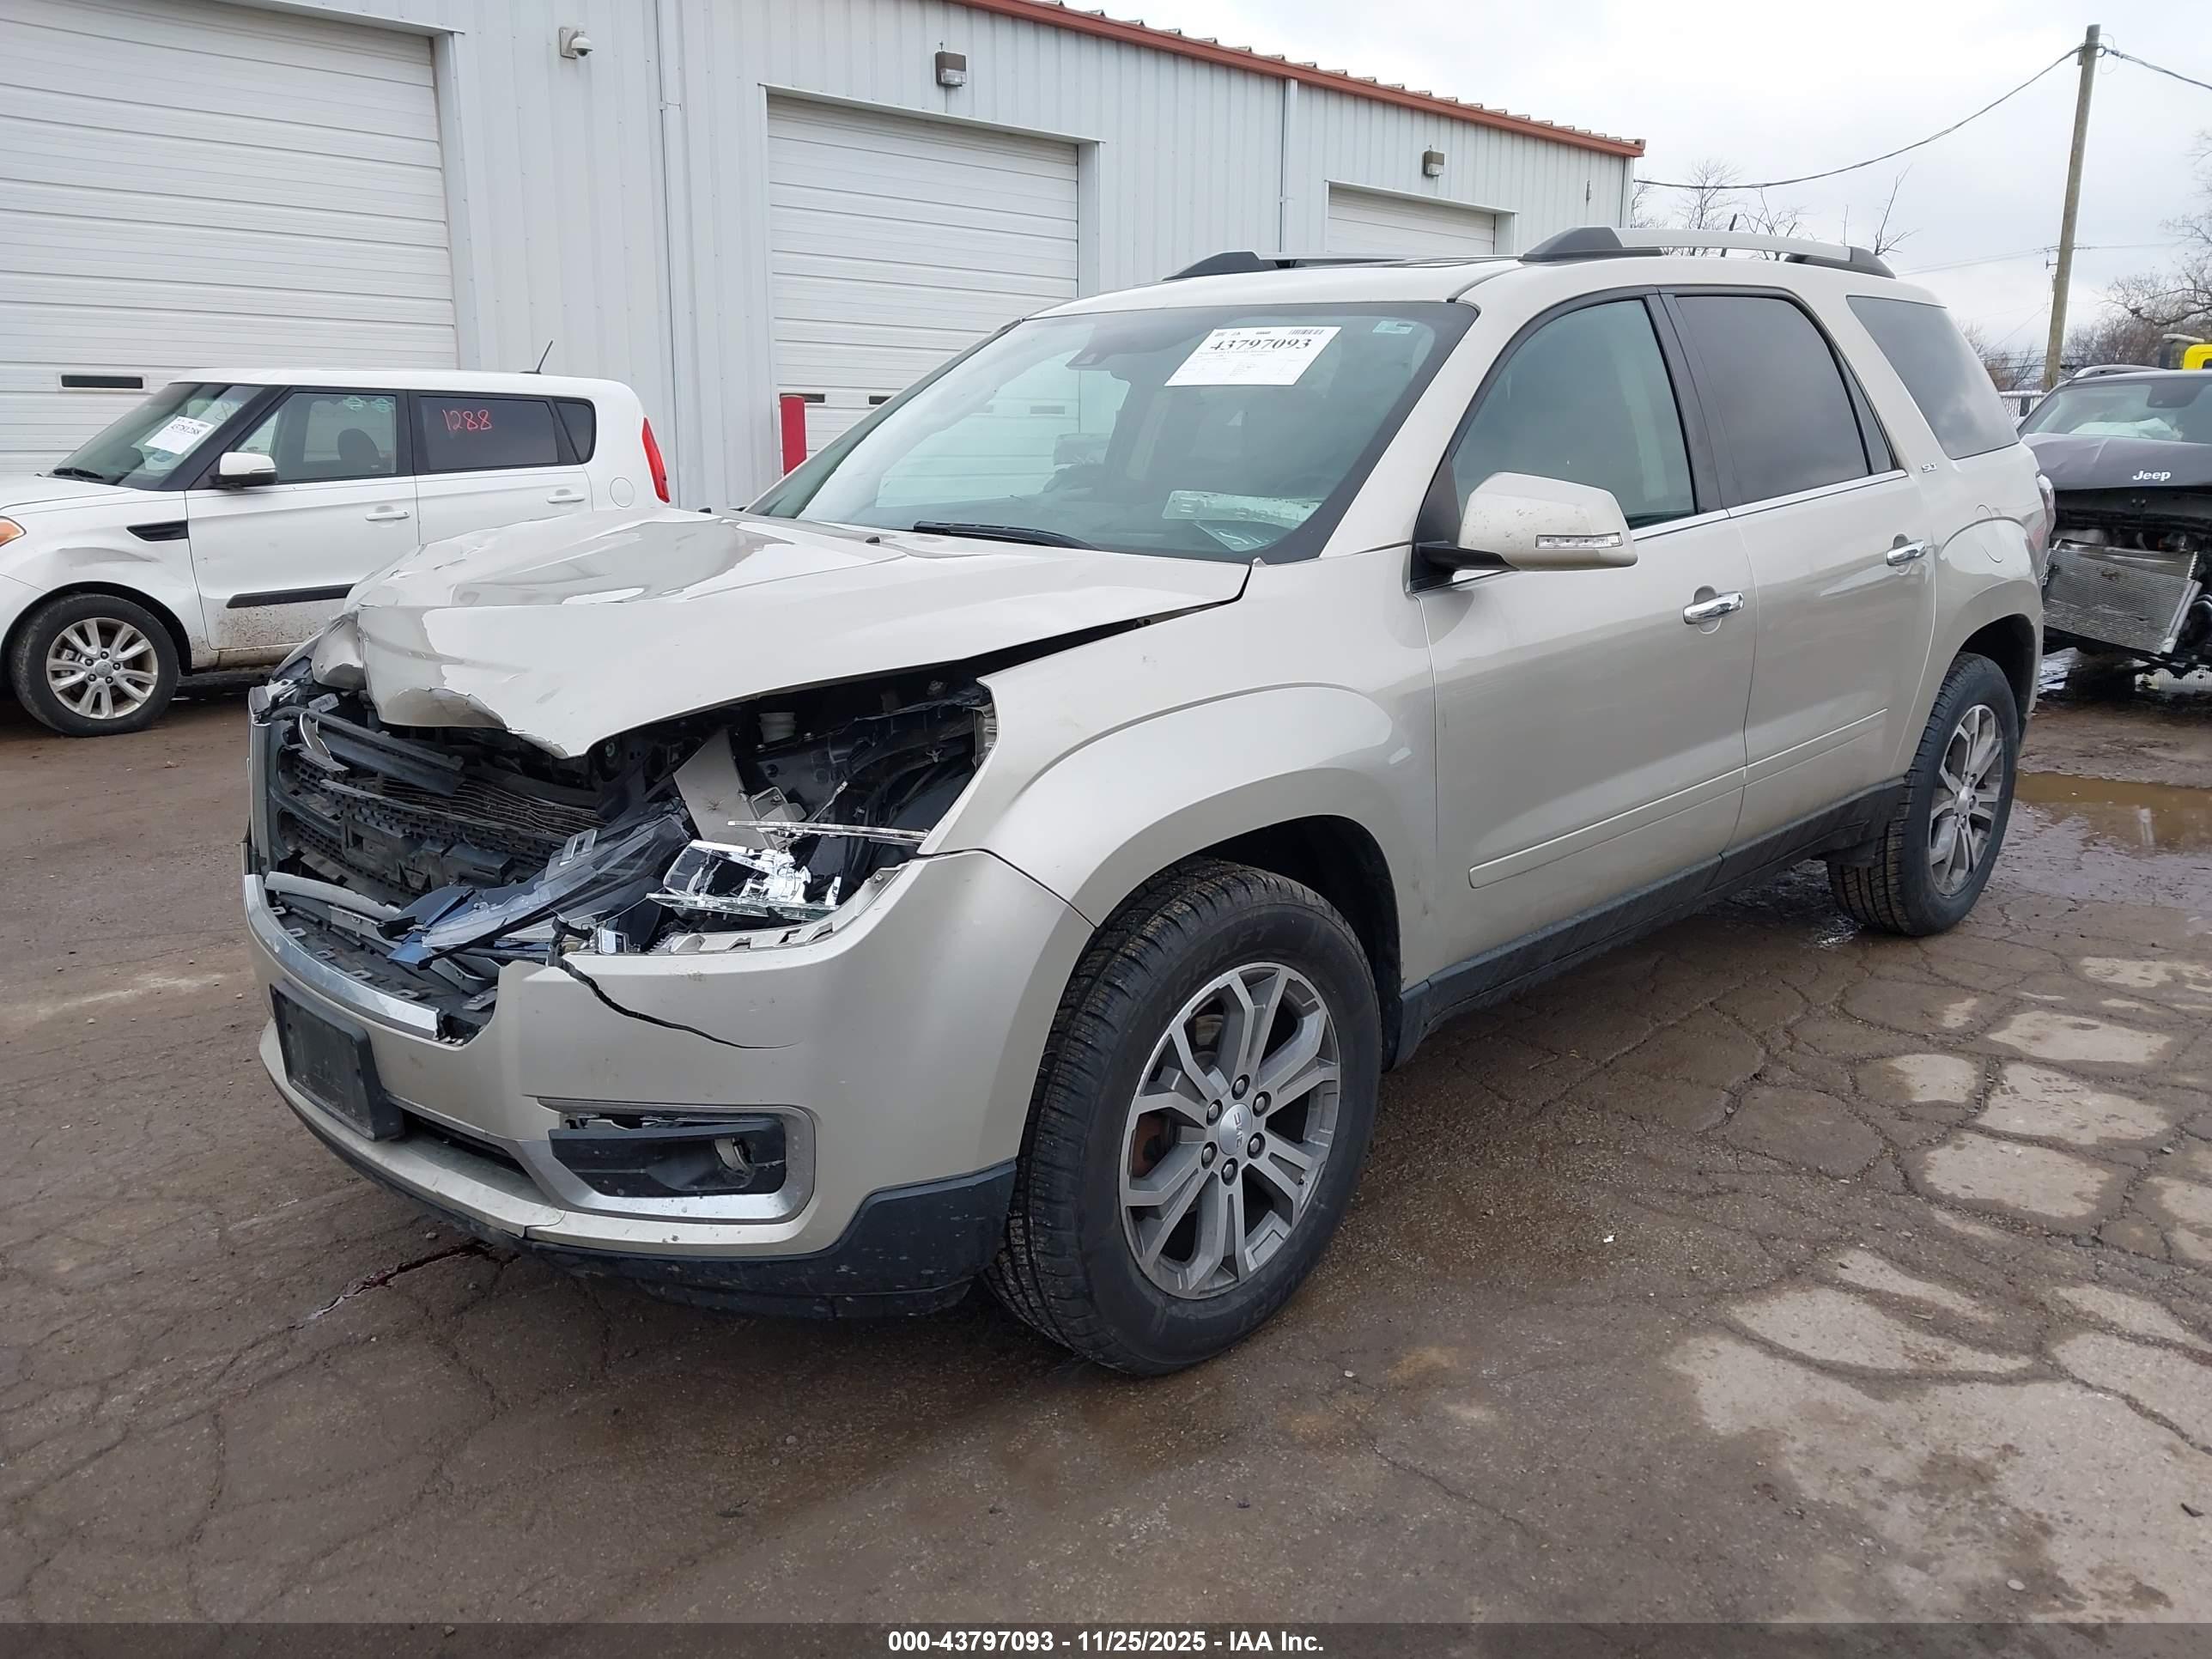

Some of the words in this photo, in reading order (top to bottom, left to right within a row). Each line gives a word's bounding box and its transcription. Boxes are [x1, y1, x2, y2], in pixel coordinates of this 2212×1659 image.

[1209, 338, 1312, 350] 43797093
[441, 409, 494, 432] 1288
[2132, 470, 2172, 482] Jeep
